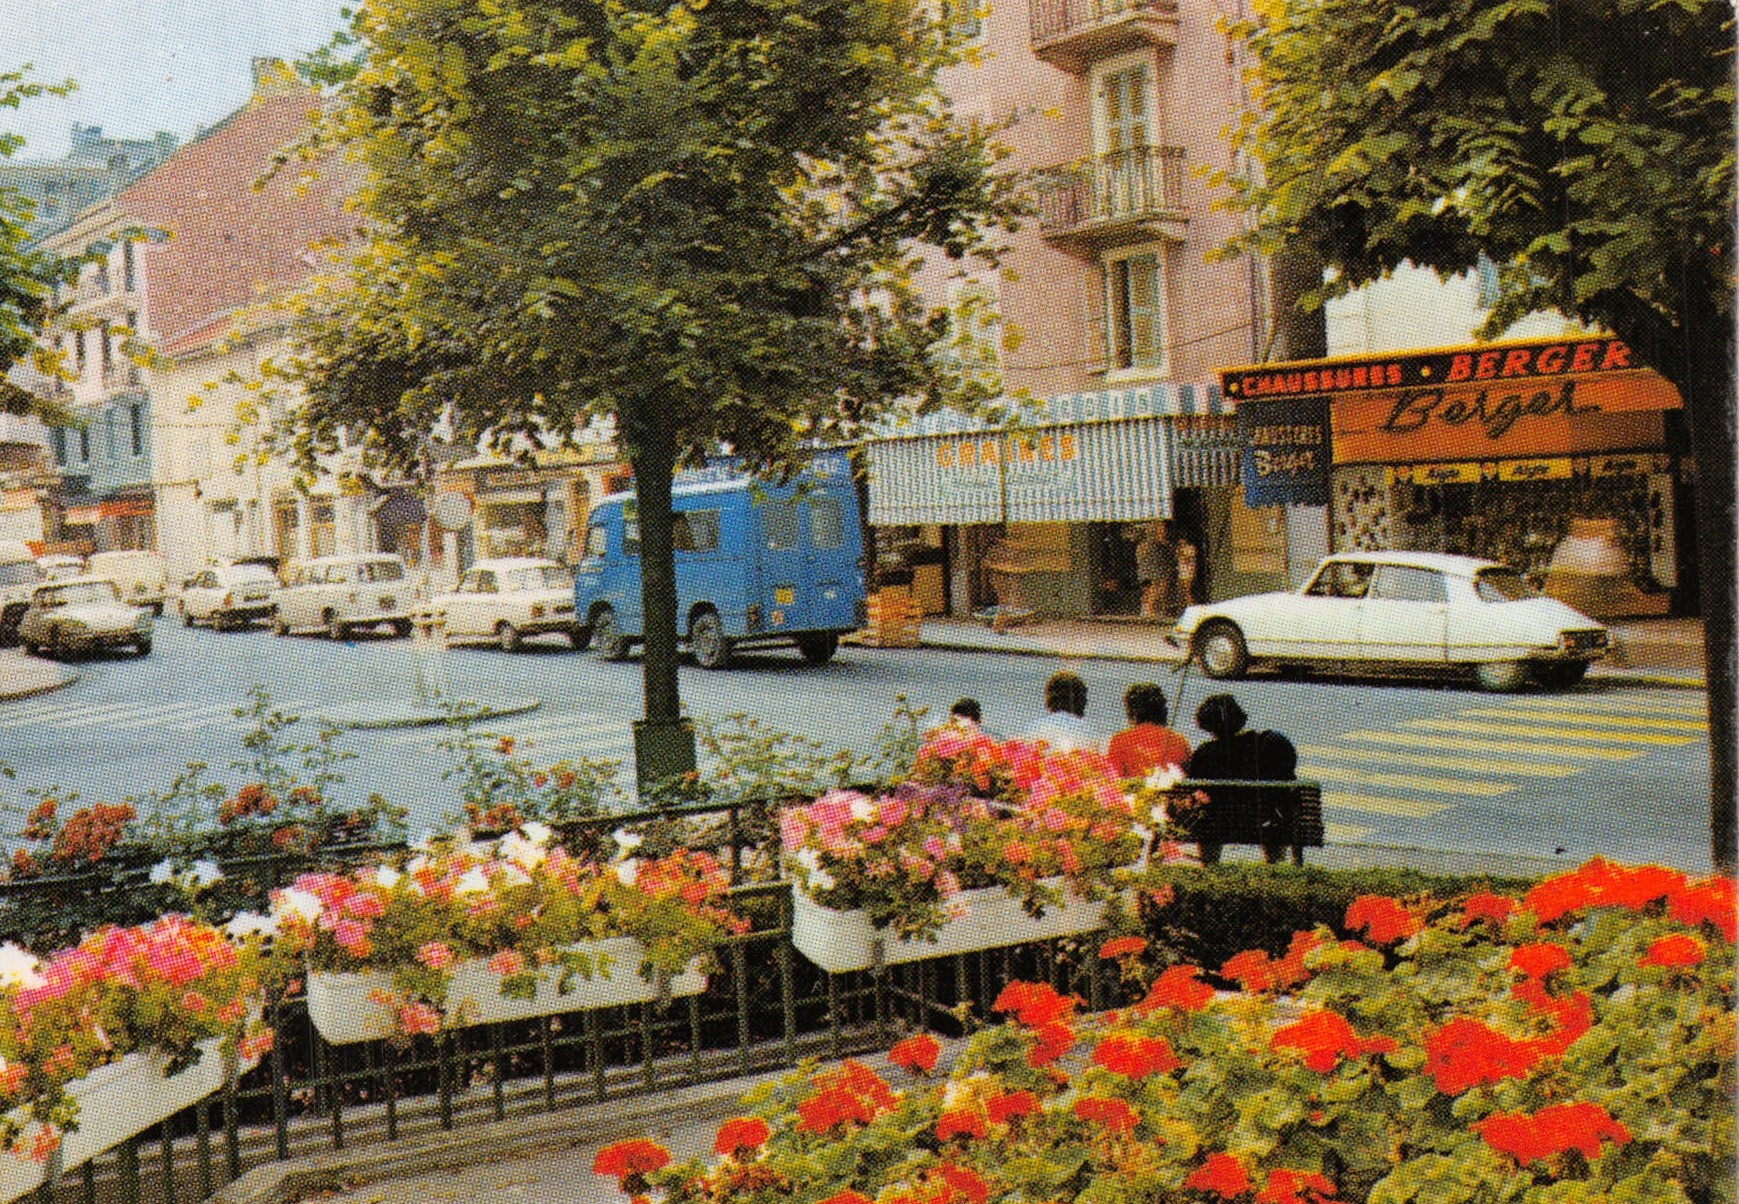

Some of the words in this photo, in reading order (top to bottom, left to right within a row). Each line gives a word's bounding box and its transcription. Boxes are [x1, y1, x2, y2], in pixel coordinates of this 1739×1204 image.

[1241, 362, 1403, 397] CHAUSSURES
[1446, 339, 1633, 383] BERGER
[1379, 378, 1600, 440] Berger
[934, 433, 1077, 468] GRAINES
